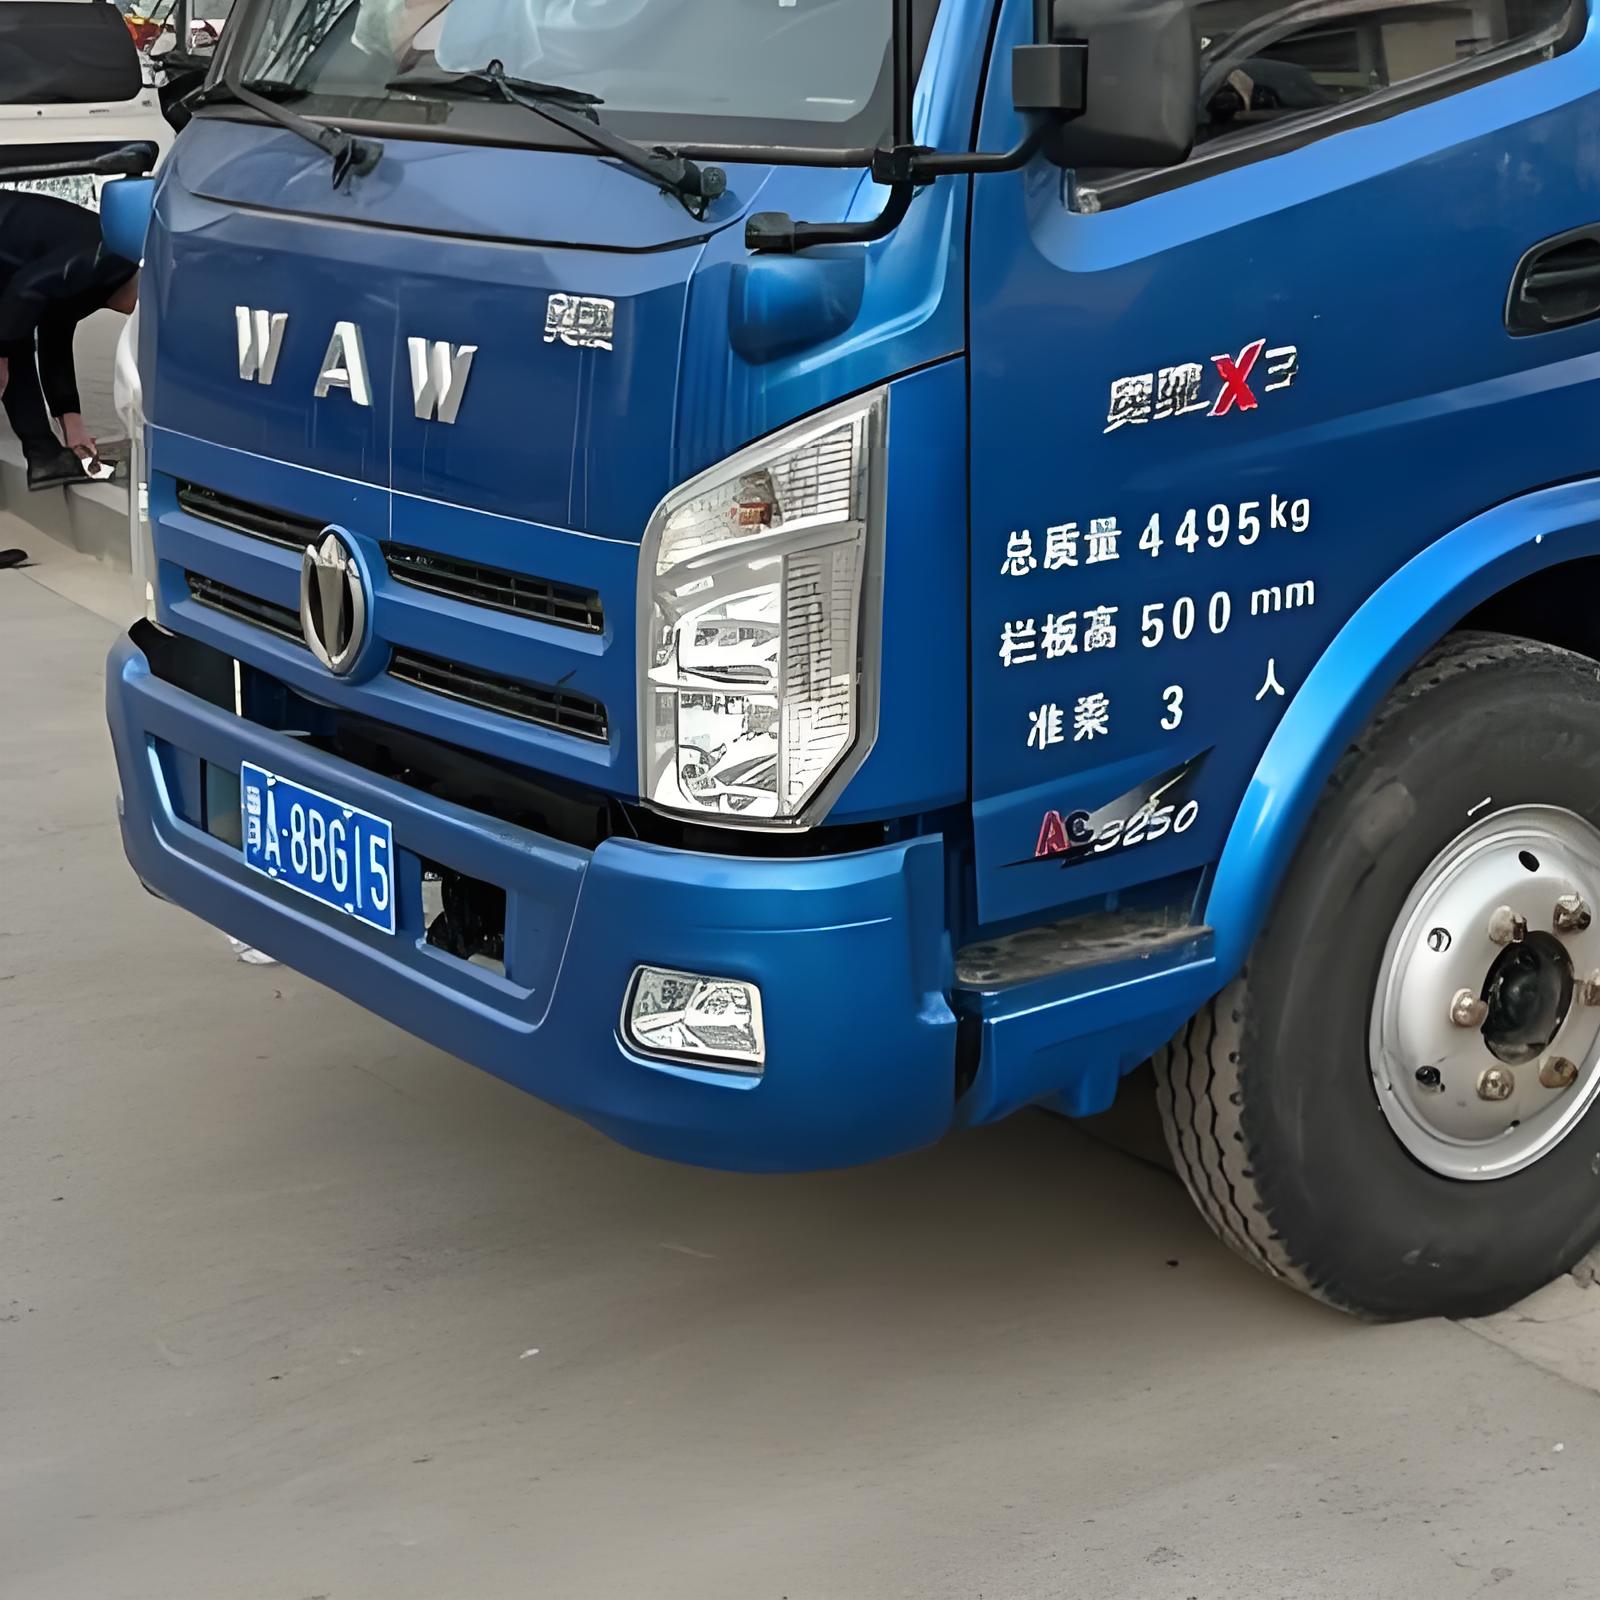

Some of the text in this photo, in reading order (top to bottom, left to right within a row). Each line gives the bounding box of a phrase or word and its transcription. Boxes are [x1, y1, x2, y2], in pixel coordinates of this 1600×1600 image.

[235, 305, 478, 424] WAW
[1000, 516, 1122, 577] 总质量
[998, 580, 1315, 668] 栏板高 500 mm
[1160, 684, 1184, 731] 3
[1255, 658, 1285, 701] 人
